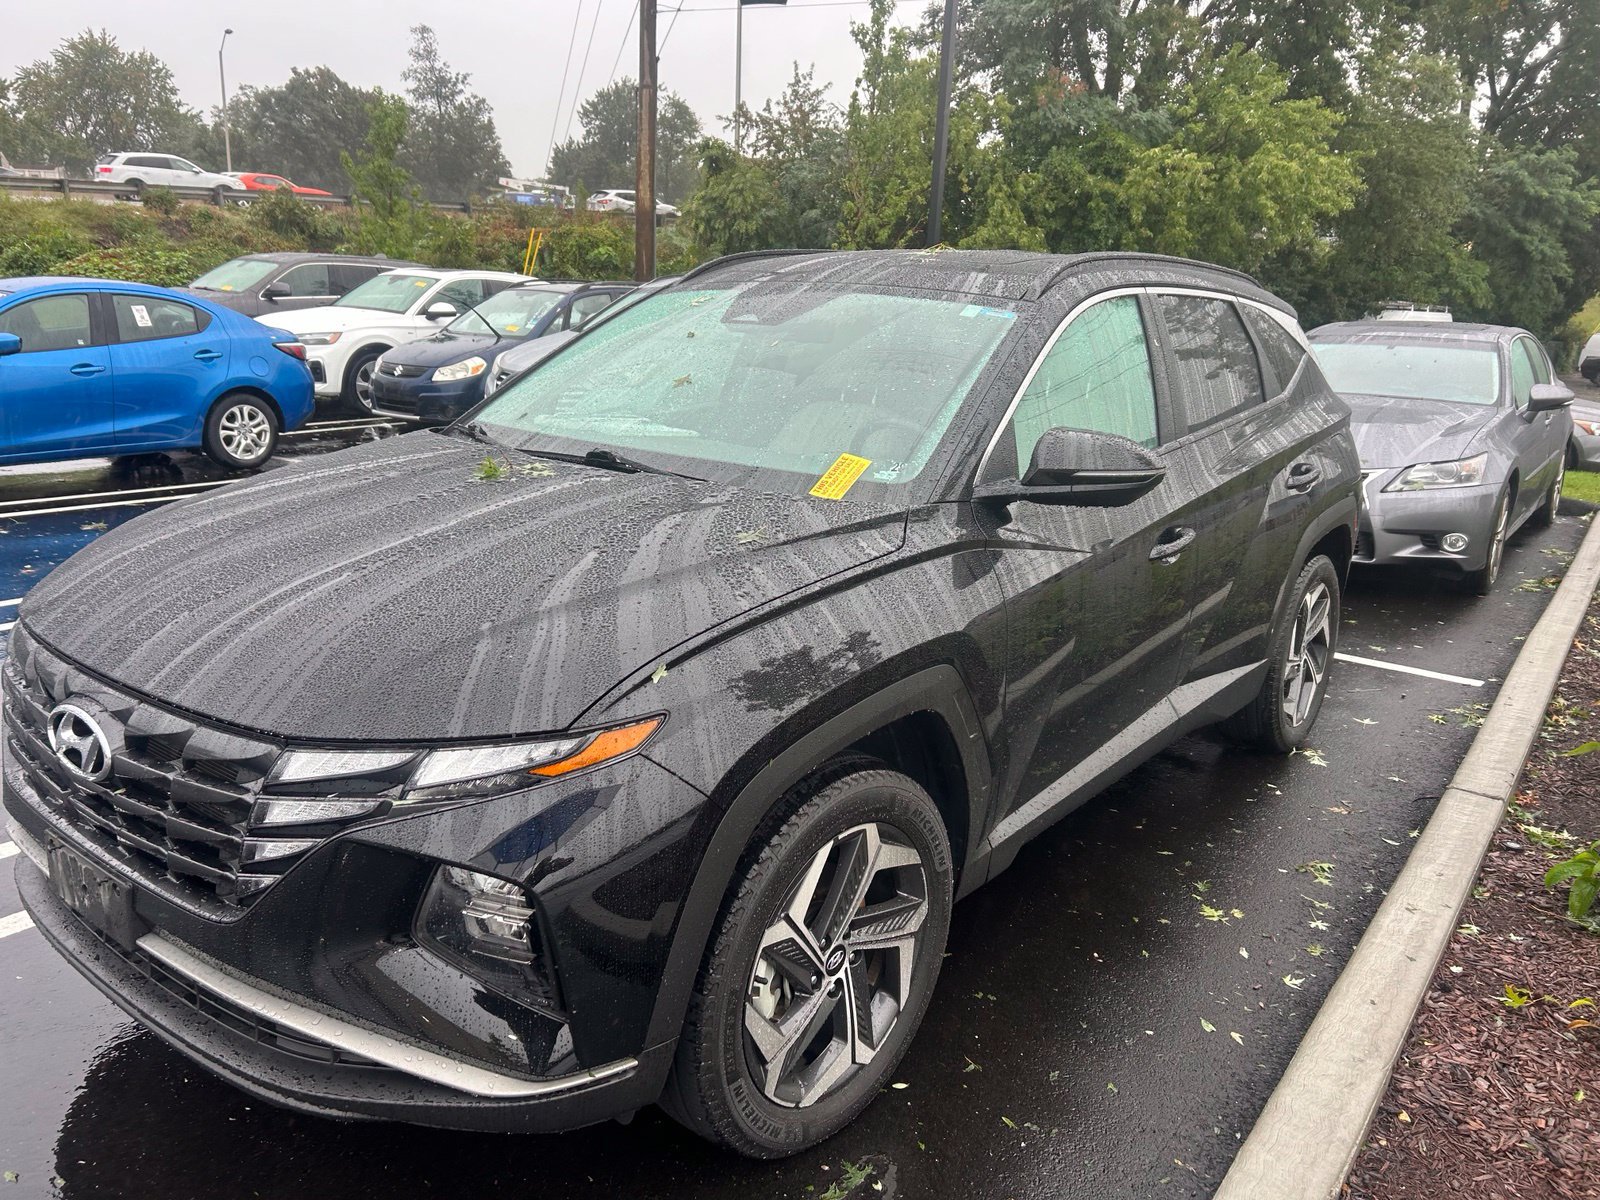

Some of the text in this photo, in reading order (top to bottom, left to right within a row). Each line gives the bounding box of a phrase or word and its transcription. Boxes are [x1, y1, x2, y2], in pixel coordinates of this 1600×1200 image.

[813, 479, 829, 493] THIS
[824, 456, 849, 479] VEHICLE
[910, 807, 947, 868] MICHELIN
[733, 1083, 784, 1139] MICHELIN
